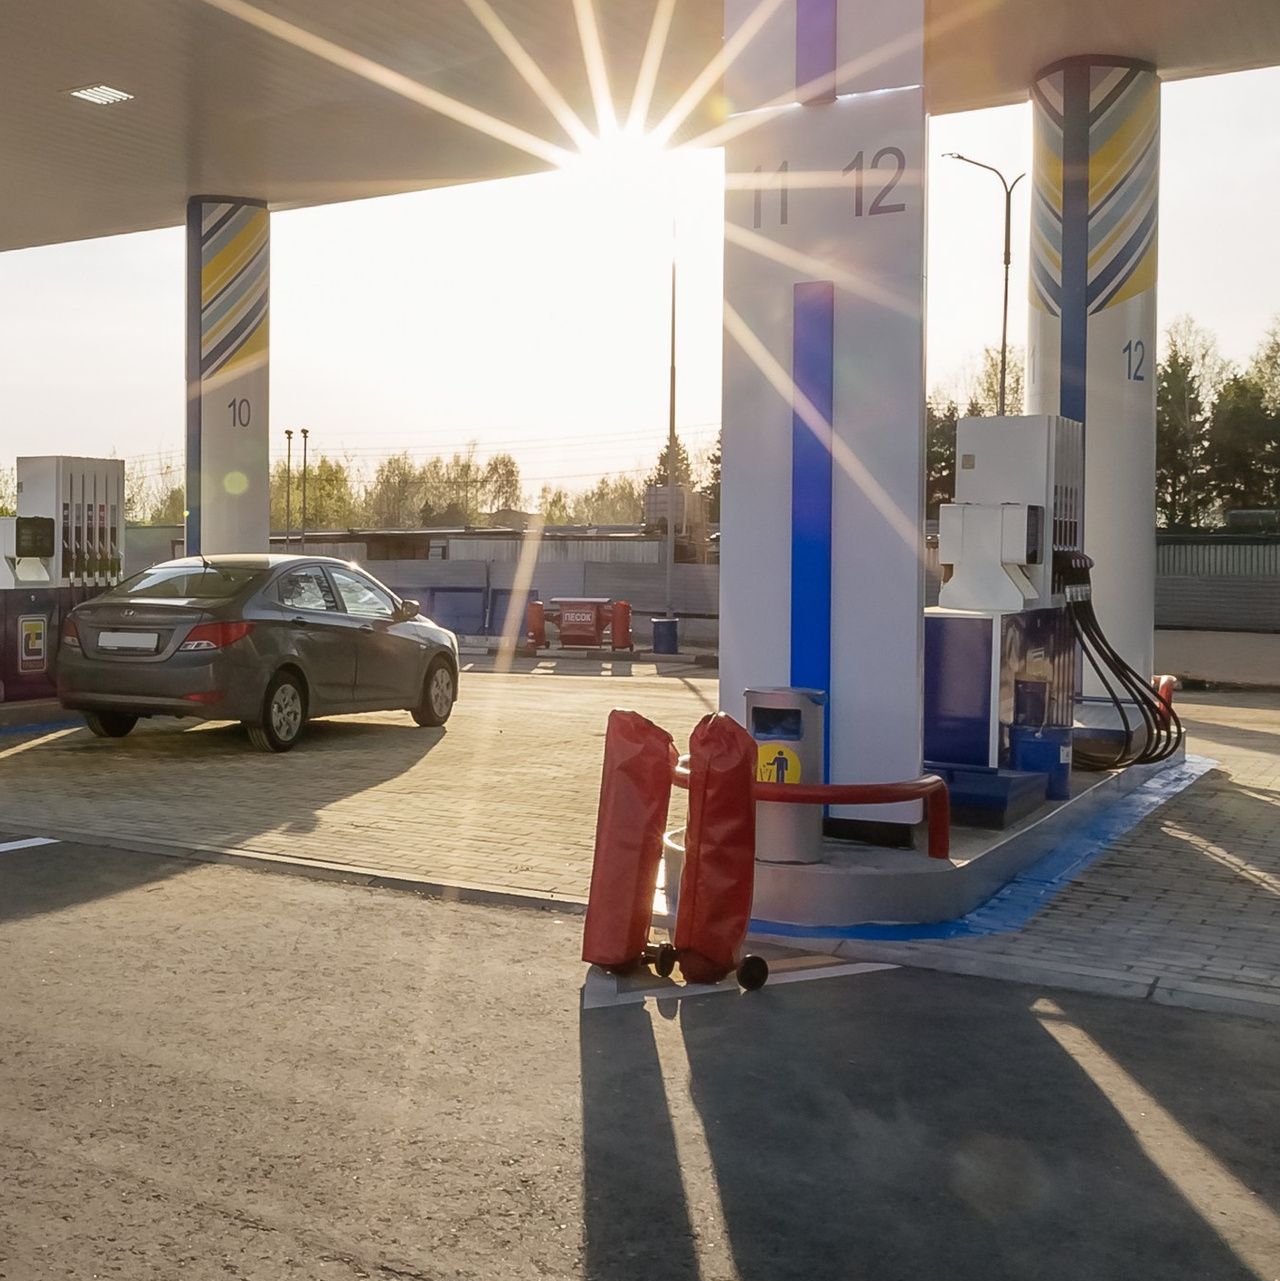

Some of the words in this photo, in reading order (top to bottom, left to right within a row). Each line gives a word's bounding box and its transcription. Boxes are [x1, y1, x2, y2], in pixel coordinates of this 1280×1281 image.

[752, 160, 788, 229] 11
[842, 146, 906, 217] 12
[1122, 339, 1145, 382] 12
[227, 397, 251, 428] 10
[564, 612, 592, 622] ПЕСОК
